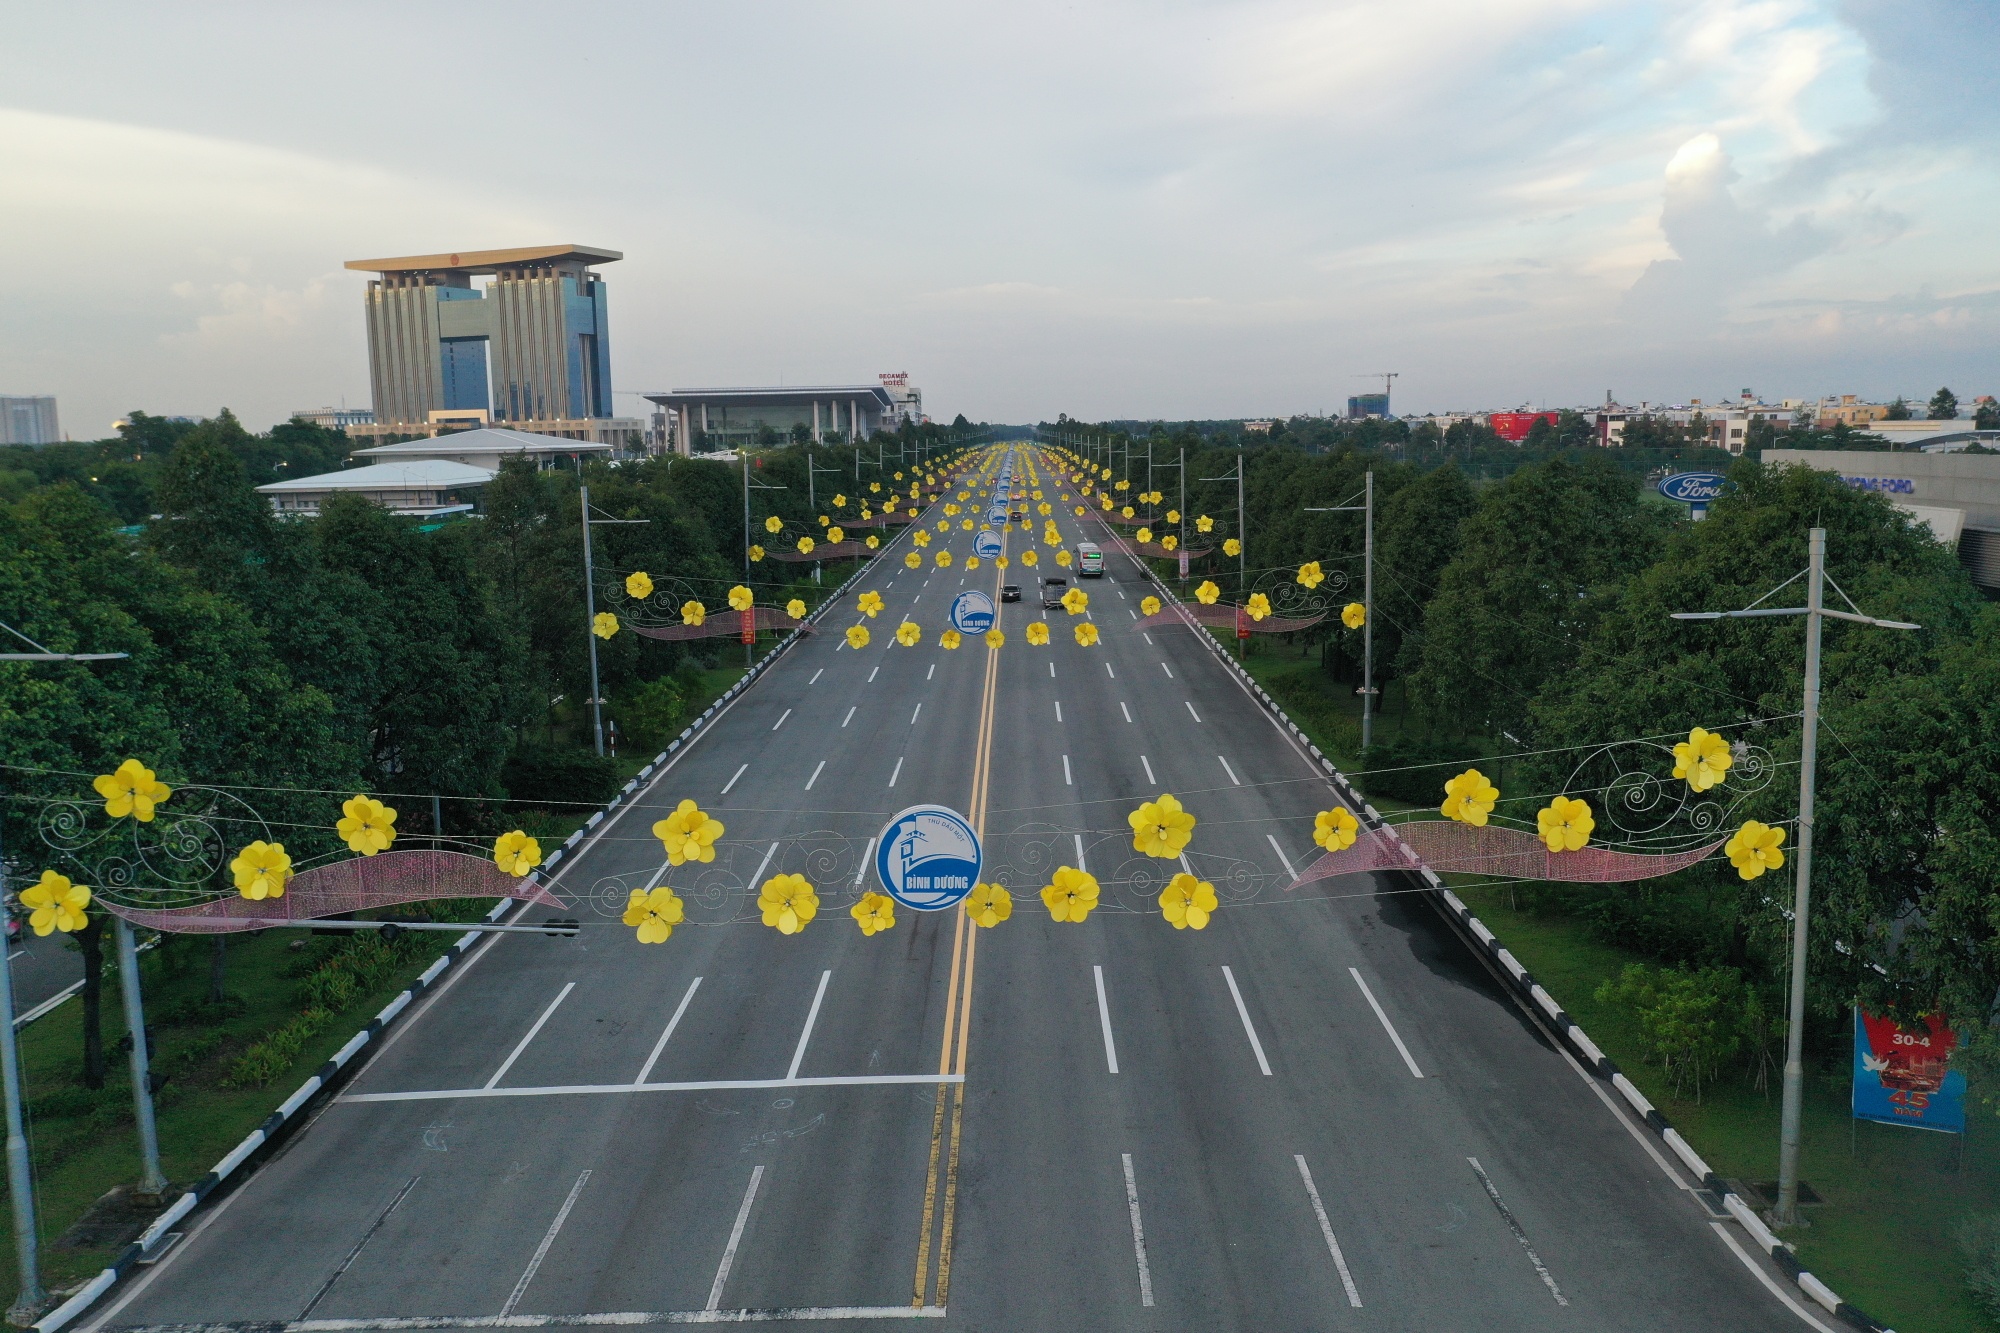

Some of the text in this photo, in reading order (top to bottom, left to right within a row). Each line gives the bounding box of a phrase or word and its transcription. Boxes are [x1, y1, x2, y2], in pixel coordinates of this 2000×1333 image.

[1881, 479, 1913, 494] FORD
[906, 874, 968, 889] BÌNH DƯƠNG
[1892, 1033, 1930, 1047] 30-4
[1888, 1091, 1930, 1109] 45
